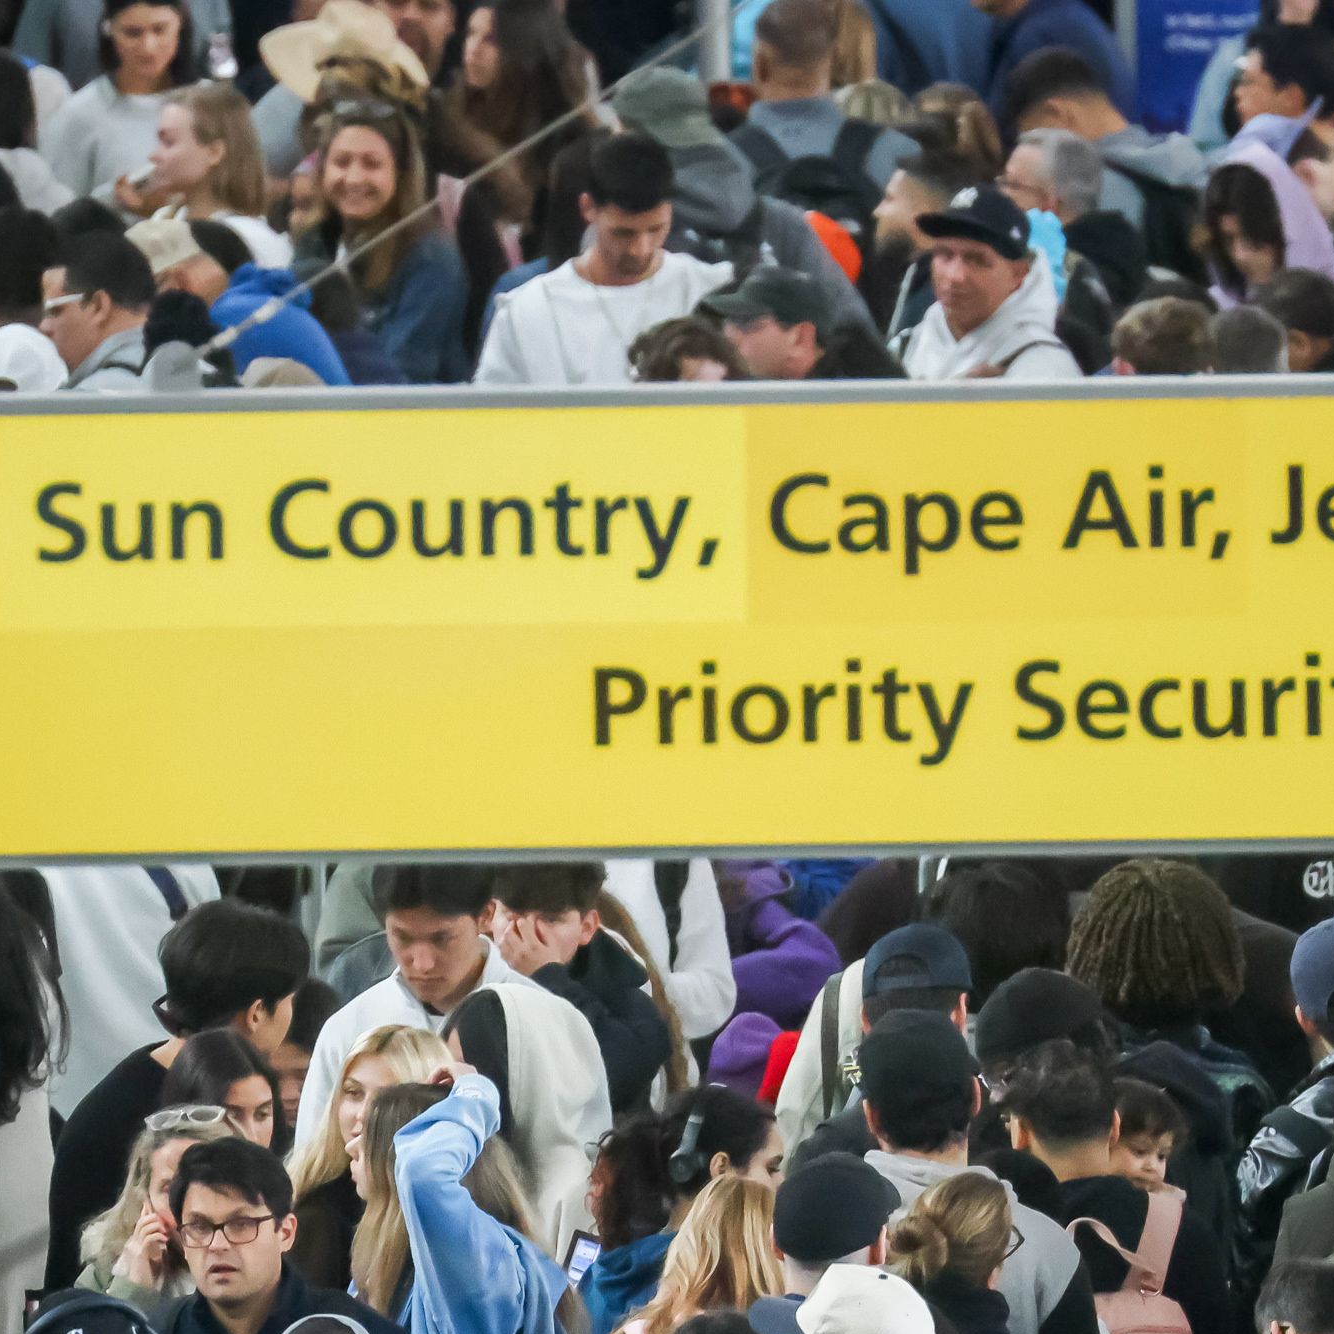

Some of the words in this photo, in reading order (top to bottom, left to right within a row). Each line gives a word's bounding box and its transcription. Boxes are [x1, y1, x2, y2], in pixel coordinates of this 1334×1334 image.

[37, 483, 223, 562] Sun
[270, 480, 717, 583] Country,
[770, 474, 1023, 576] Cape
[1063, 466, 1229, 561] Air,
[593, 660, 973, 766] Priority
